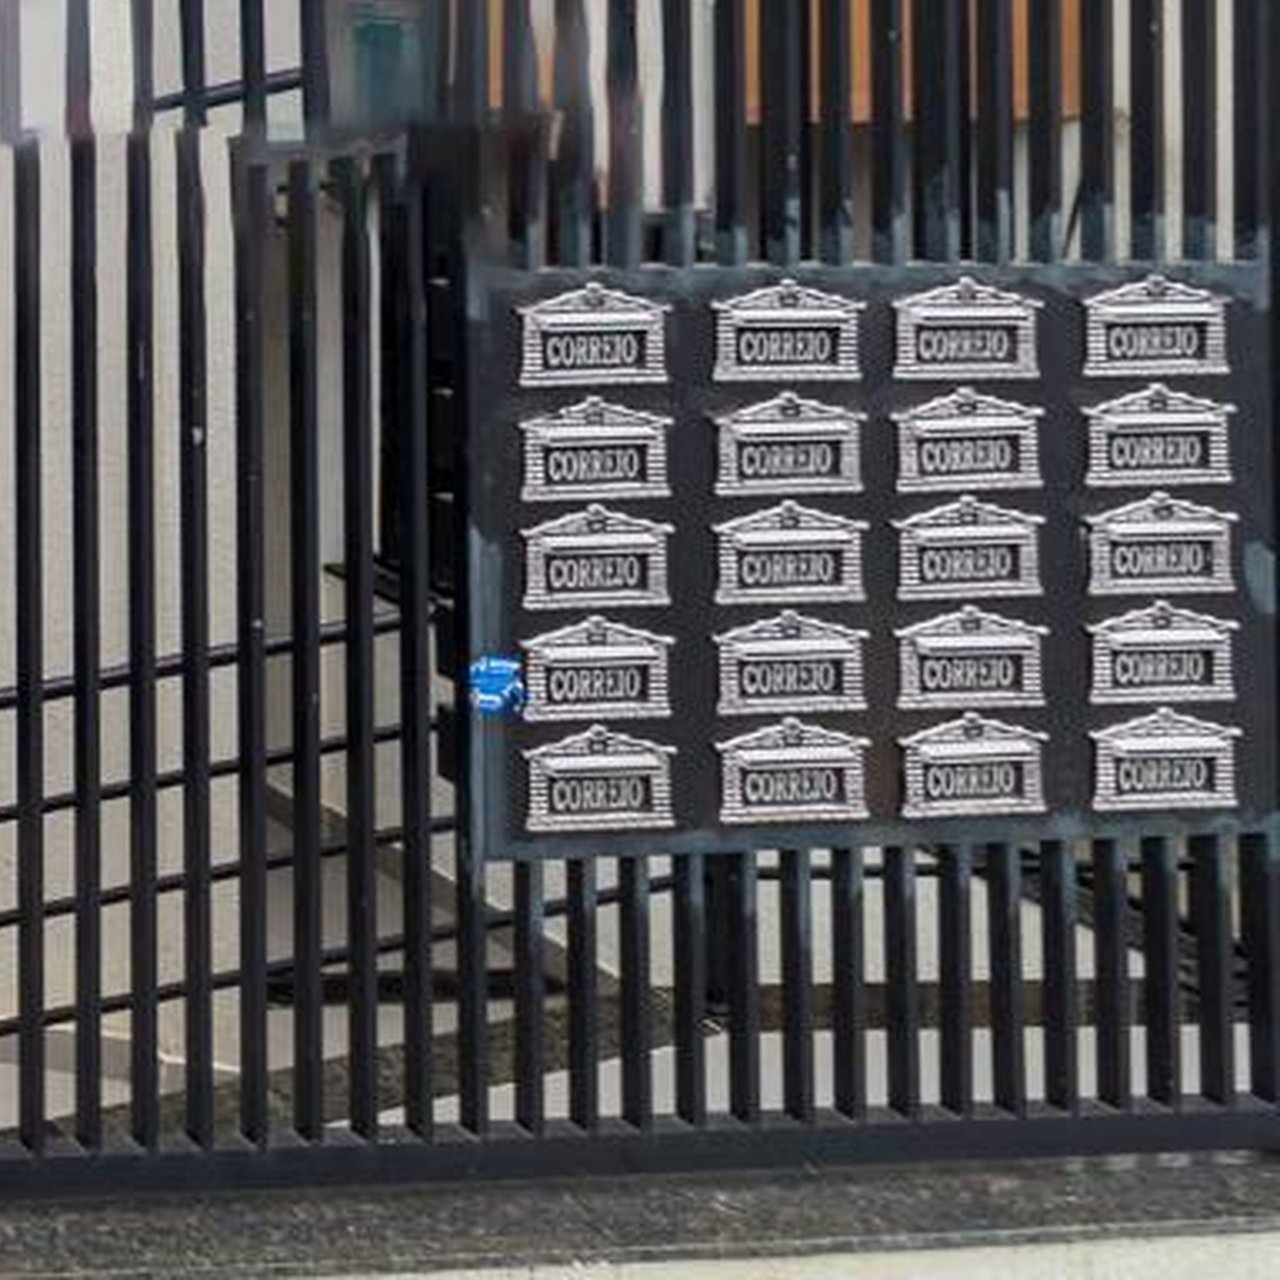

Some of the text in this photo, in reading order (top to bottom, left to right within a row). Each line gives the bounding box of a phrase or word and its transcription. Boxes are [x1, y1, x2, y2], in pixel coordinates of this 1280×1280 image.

[546, 333, 638, 365] CORREIO
[740, 330, 831, 361] CORREIO
[919, 329, 1009, 360] CORREIO
[1109, 326, 1198, 357] CORREIO
[548, 448, 640, 481] CORREIO
[741, 443, 833, 476] CORREIO
[921, 439, 1012, 472] CORREIO
[1111, 436, 1201, 468] CORREIO
[549, 555, 640, 588] CORREIO
[742, 553, 834, 585] CORREIO
[922, 548, 1012, 580] CORREIO
[1114, 543, 1203, 575] CORREIO
[742, 662, 835, 694] CORREIO
[922, 656, 1014, 689] CORREIO
[1115, 652, 1205, 684] CORREIO
[550, 668, 640, 701] CORREIO
[745, 770, 837, 803] CORREIO
[926, 763, 1015, 797] CORREIO
[1118, 758, 1208, 791] CORREIO
[552, 777, 643, 811] CORREIO
